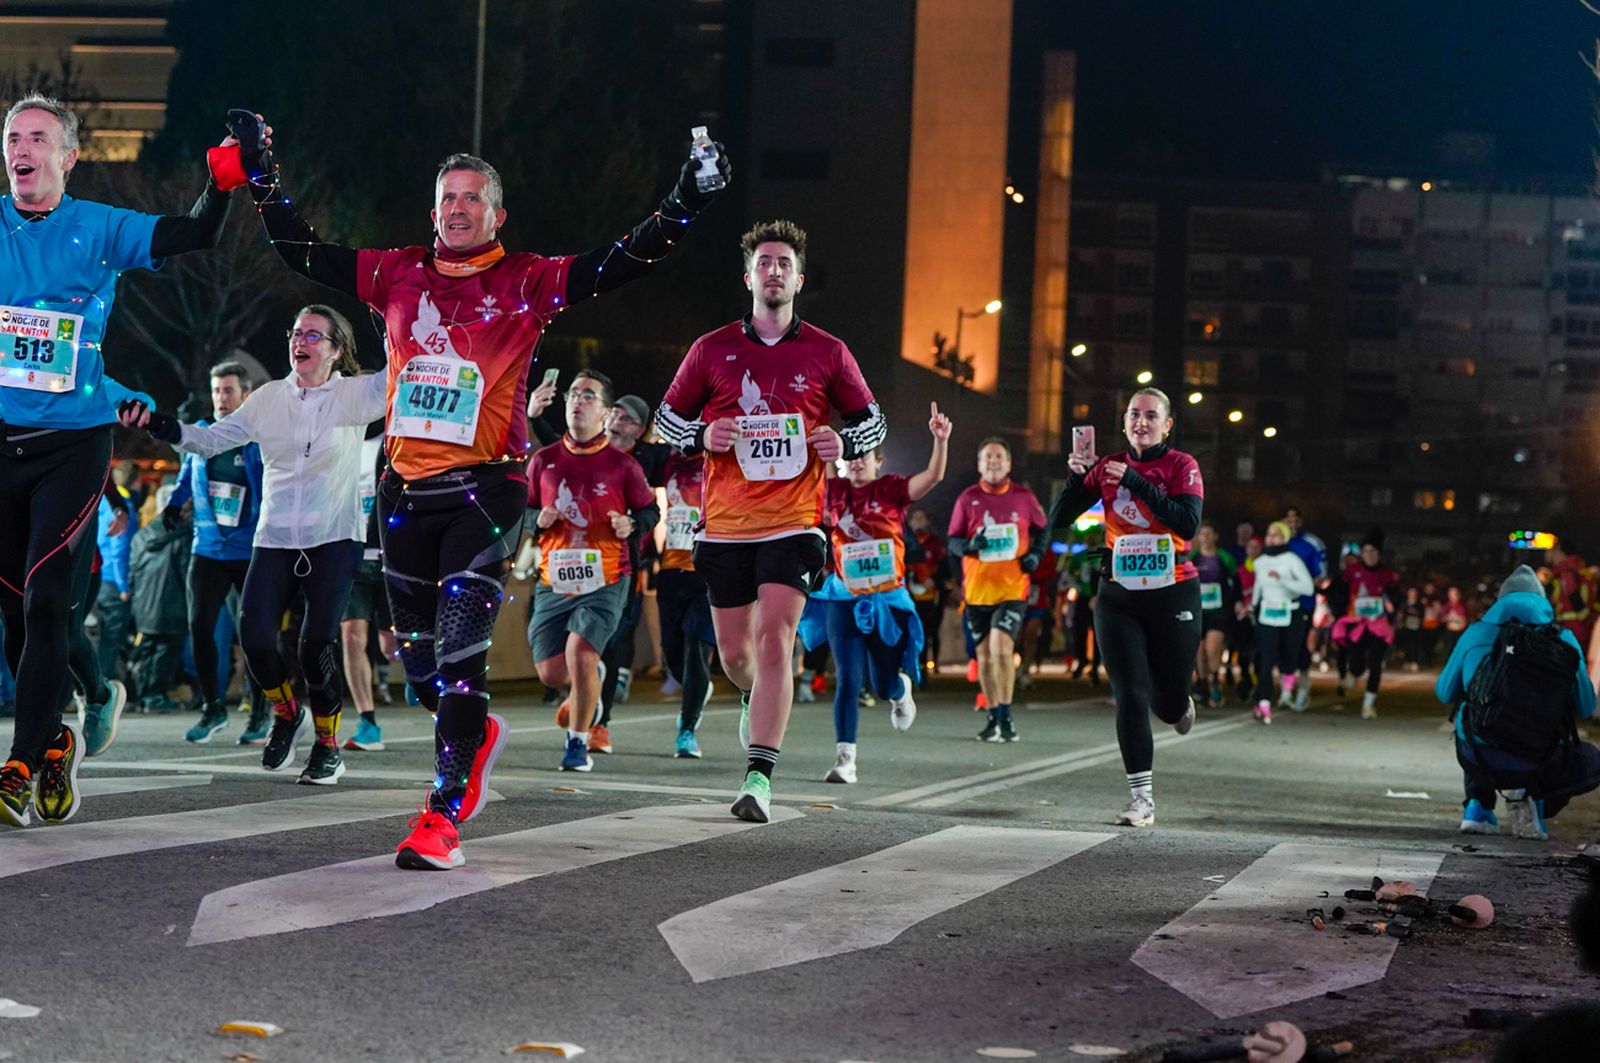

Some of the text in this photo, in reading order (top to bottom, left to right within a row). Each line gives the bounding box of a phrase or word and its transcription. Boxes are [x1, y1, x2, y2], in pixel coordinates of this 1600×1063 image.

[12, 316, 38, 326] NOCHE
[39, 319, 50, 328] DE
[1, 325, 18, 334] SAN
[424, 332, 447, 354] 43
[14, 337, 55, 364] 513
[415, 363, 438, 374] NOCHE
[440, 367, 450, 375] DE
[406, 373, 420, 383] SAN
[409, 384, 461, 413] 4877
[750, 421, 779, 430] NOCHE DE
[750, 438, 791, 458] 2671
[566, 505, 578, 519] 43
[1122, 506, 1136, 520] 43
[857, 558, 880, 573] 144
[1121, 554, 1167, 572] 13239
[558, 566, 594, 581] 6036
